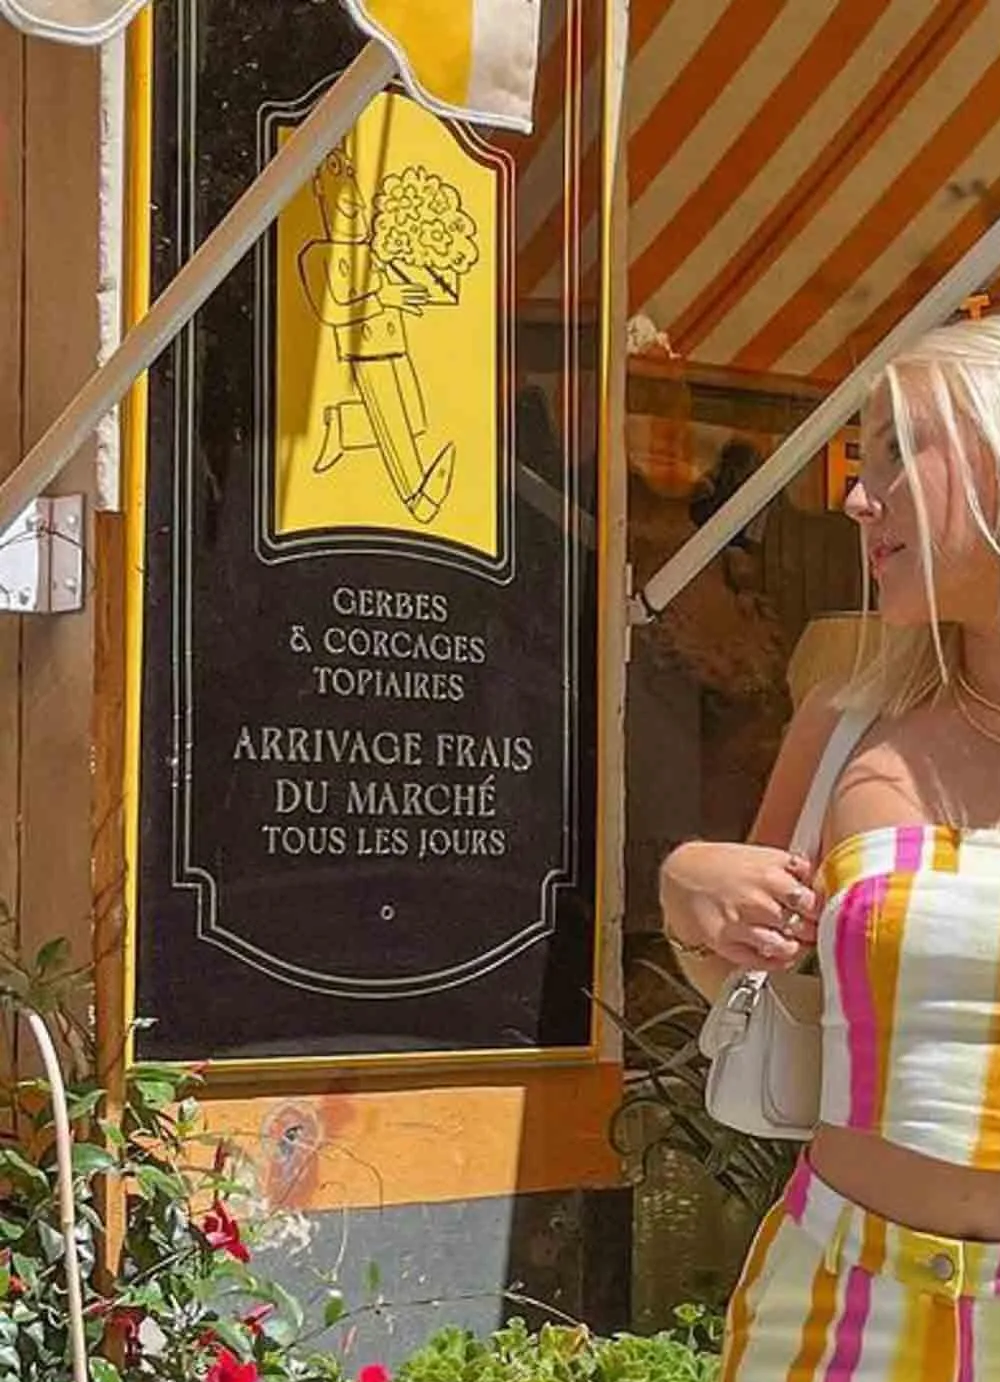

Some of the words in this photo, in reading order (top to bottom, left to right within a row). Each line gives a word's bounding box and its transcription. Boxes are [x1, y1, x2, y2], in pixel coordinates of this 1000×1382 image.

[332, 586, 448, 622] GERBES
[289, 625, 312, 653] &
[323, 627, 486, 664] CORCAGES
[313, 666, 465, 701] TOPIAIRES
[233, 726, 422, 765] ARRIVAGE
[437, 733, 534, 772] FRAIS
[275, 778, 329, 814] DU
[347, 774, 497, 817] MARCHÉ
[262, 825, 347, 855] TOUS
[357, 828, 409, 855] LES
[418, 829, 506, 858] JOURS
